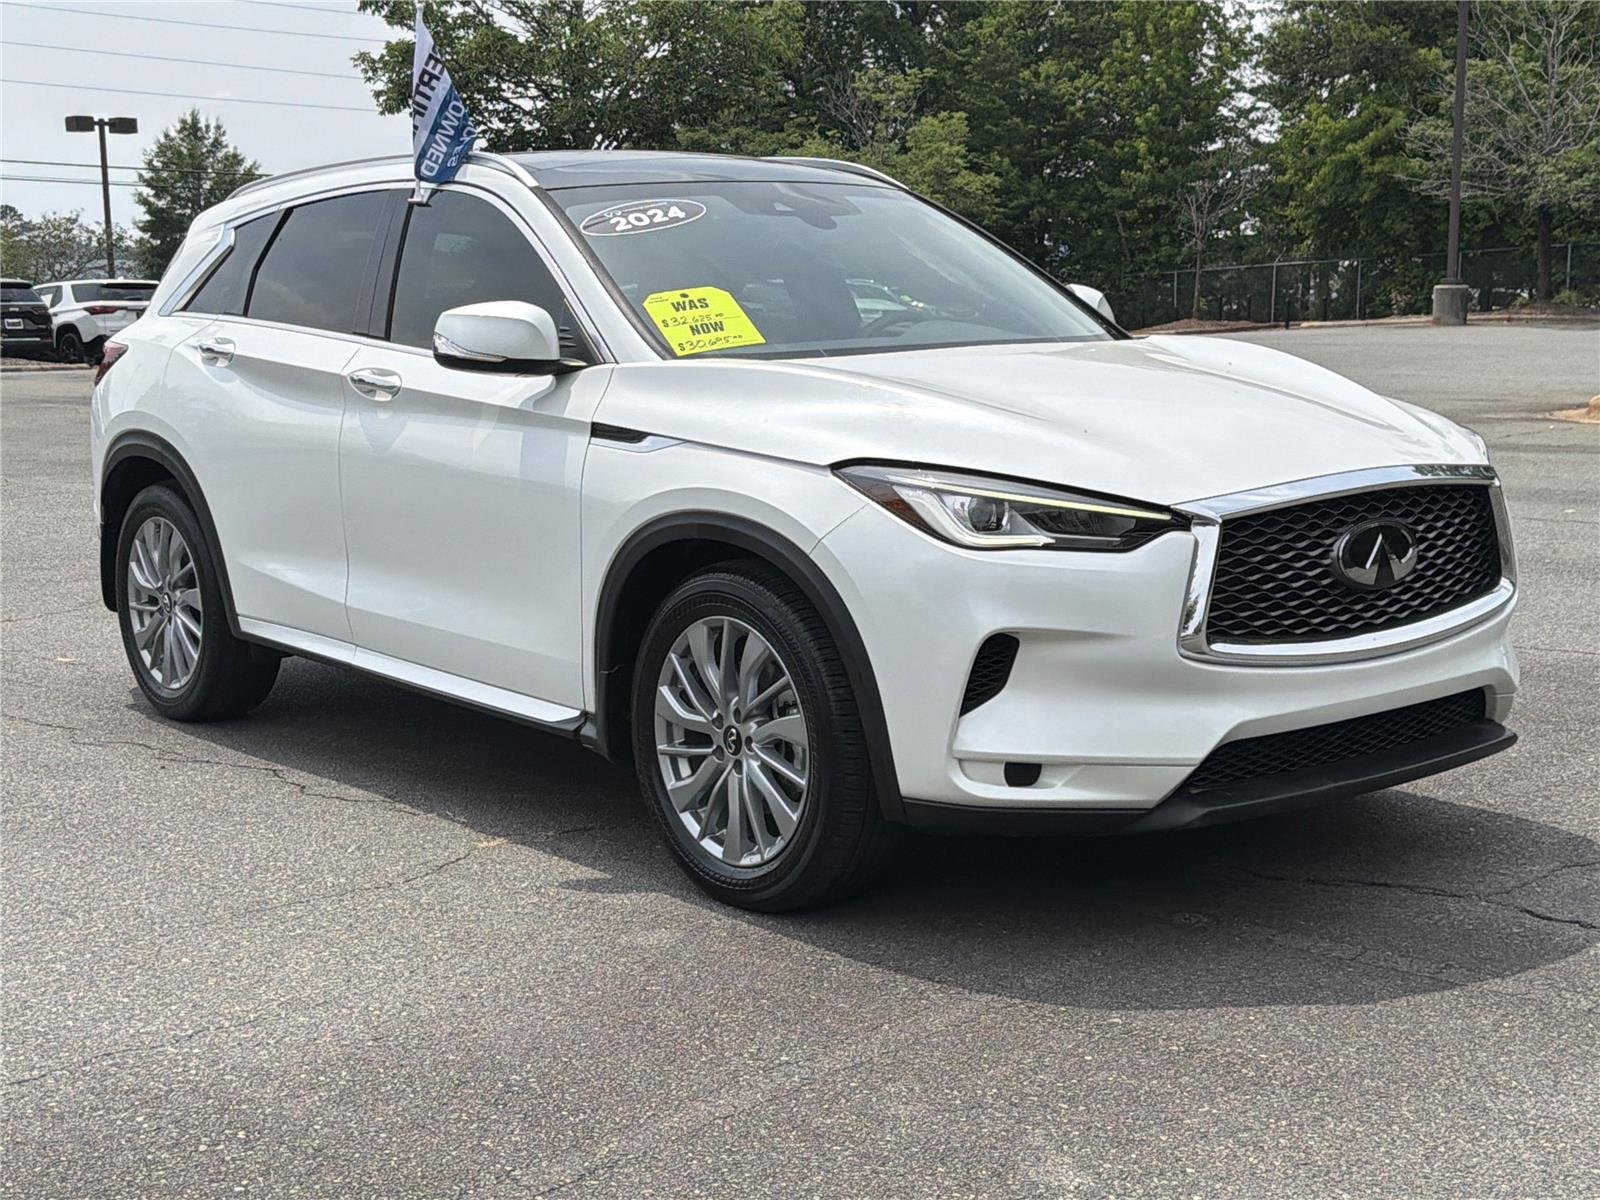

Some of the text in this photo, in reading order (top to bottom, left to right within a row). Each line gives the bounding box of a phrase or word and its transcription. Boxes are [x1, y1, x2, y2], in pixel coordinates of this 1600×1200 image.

[609, 205, 686, 231] 2024
[670, 297, 710, 313] WAS
[689, 320, 726, 337] NOW
